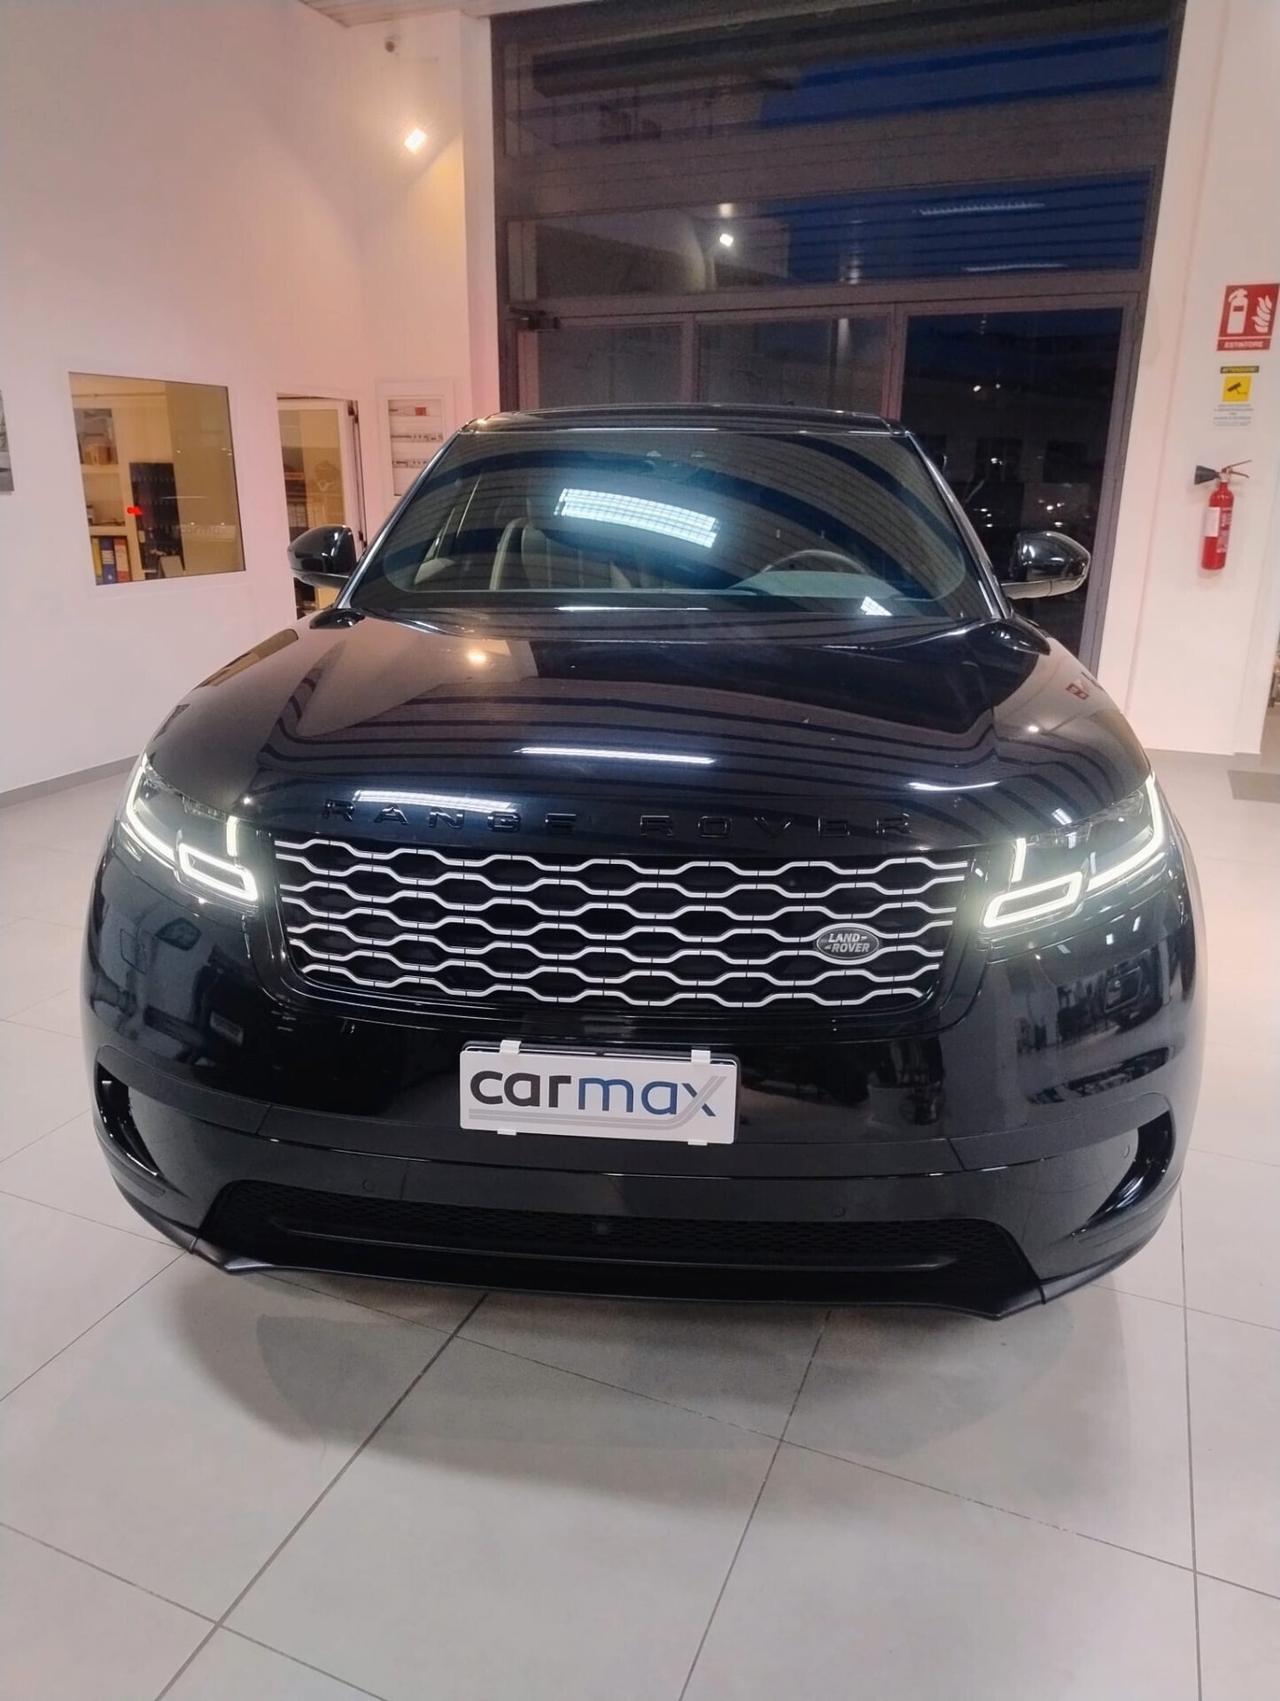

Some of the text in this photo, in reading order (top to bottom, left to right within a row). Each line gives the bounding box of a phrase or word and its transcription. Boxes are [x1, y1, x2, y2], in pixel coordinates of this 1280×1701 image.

[322, 798, 913, 838] RANGE ROVER
[828, 933, 861, 943] LAND
[831, 942, 871, 953] ROVER
[470, 1070, 727, 1117] carmax
